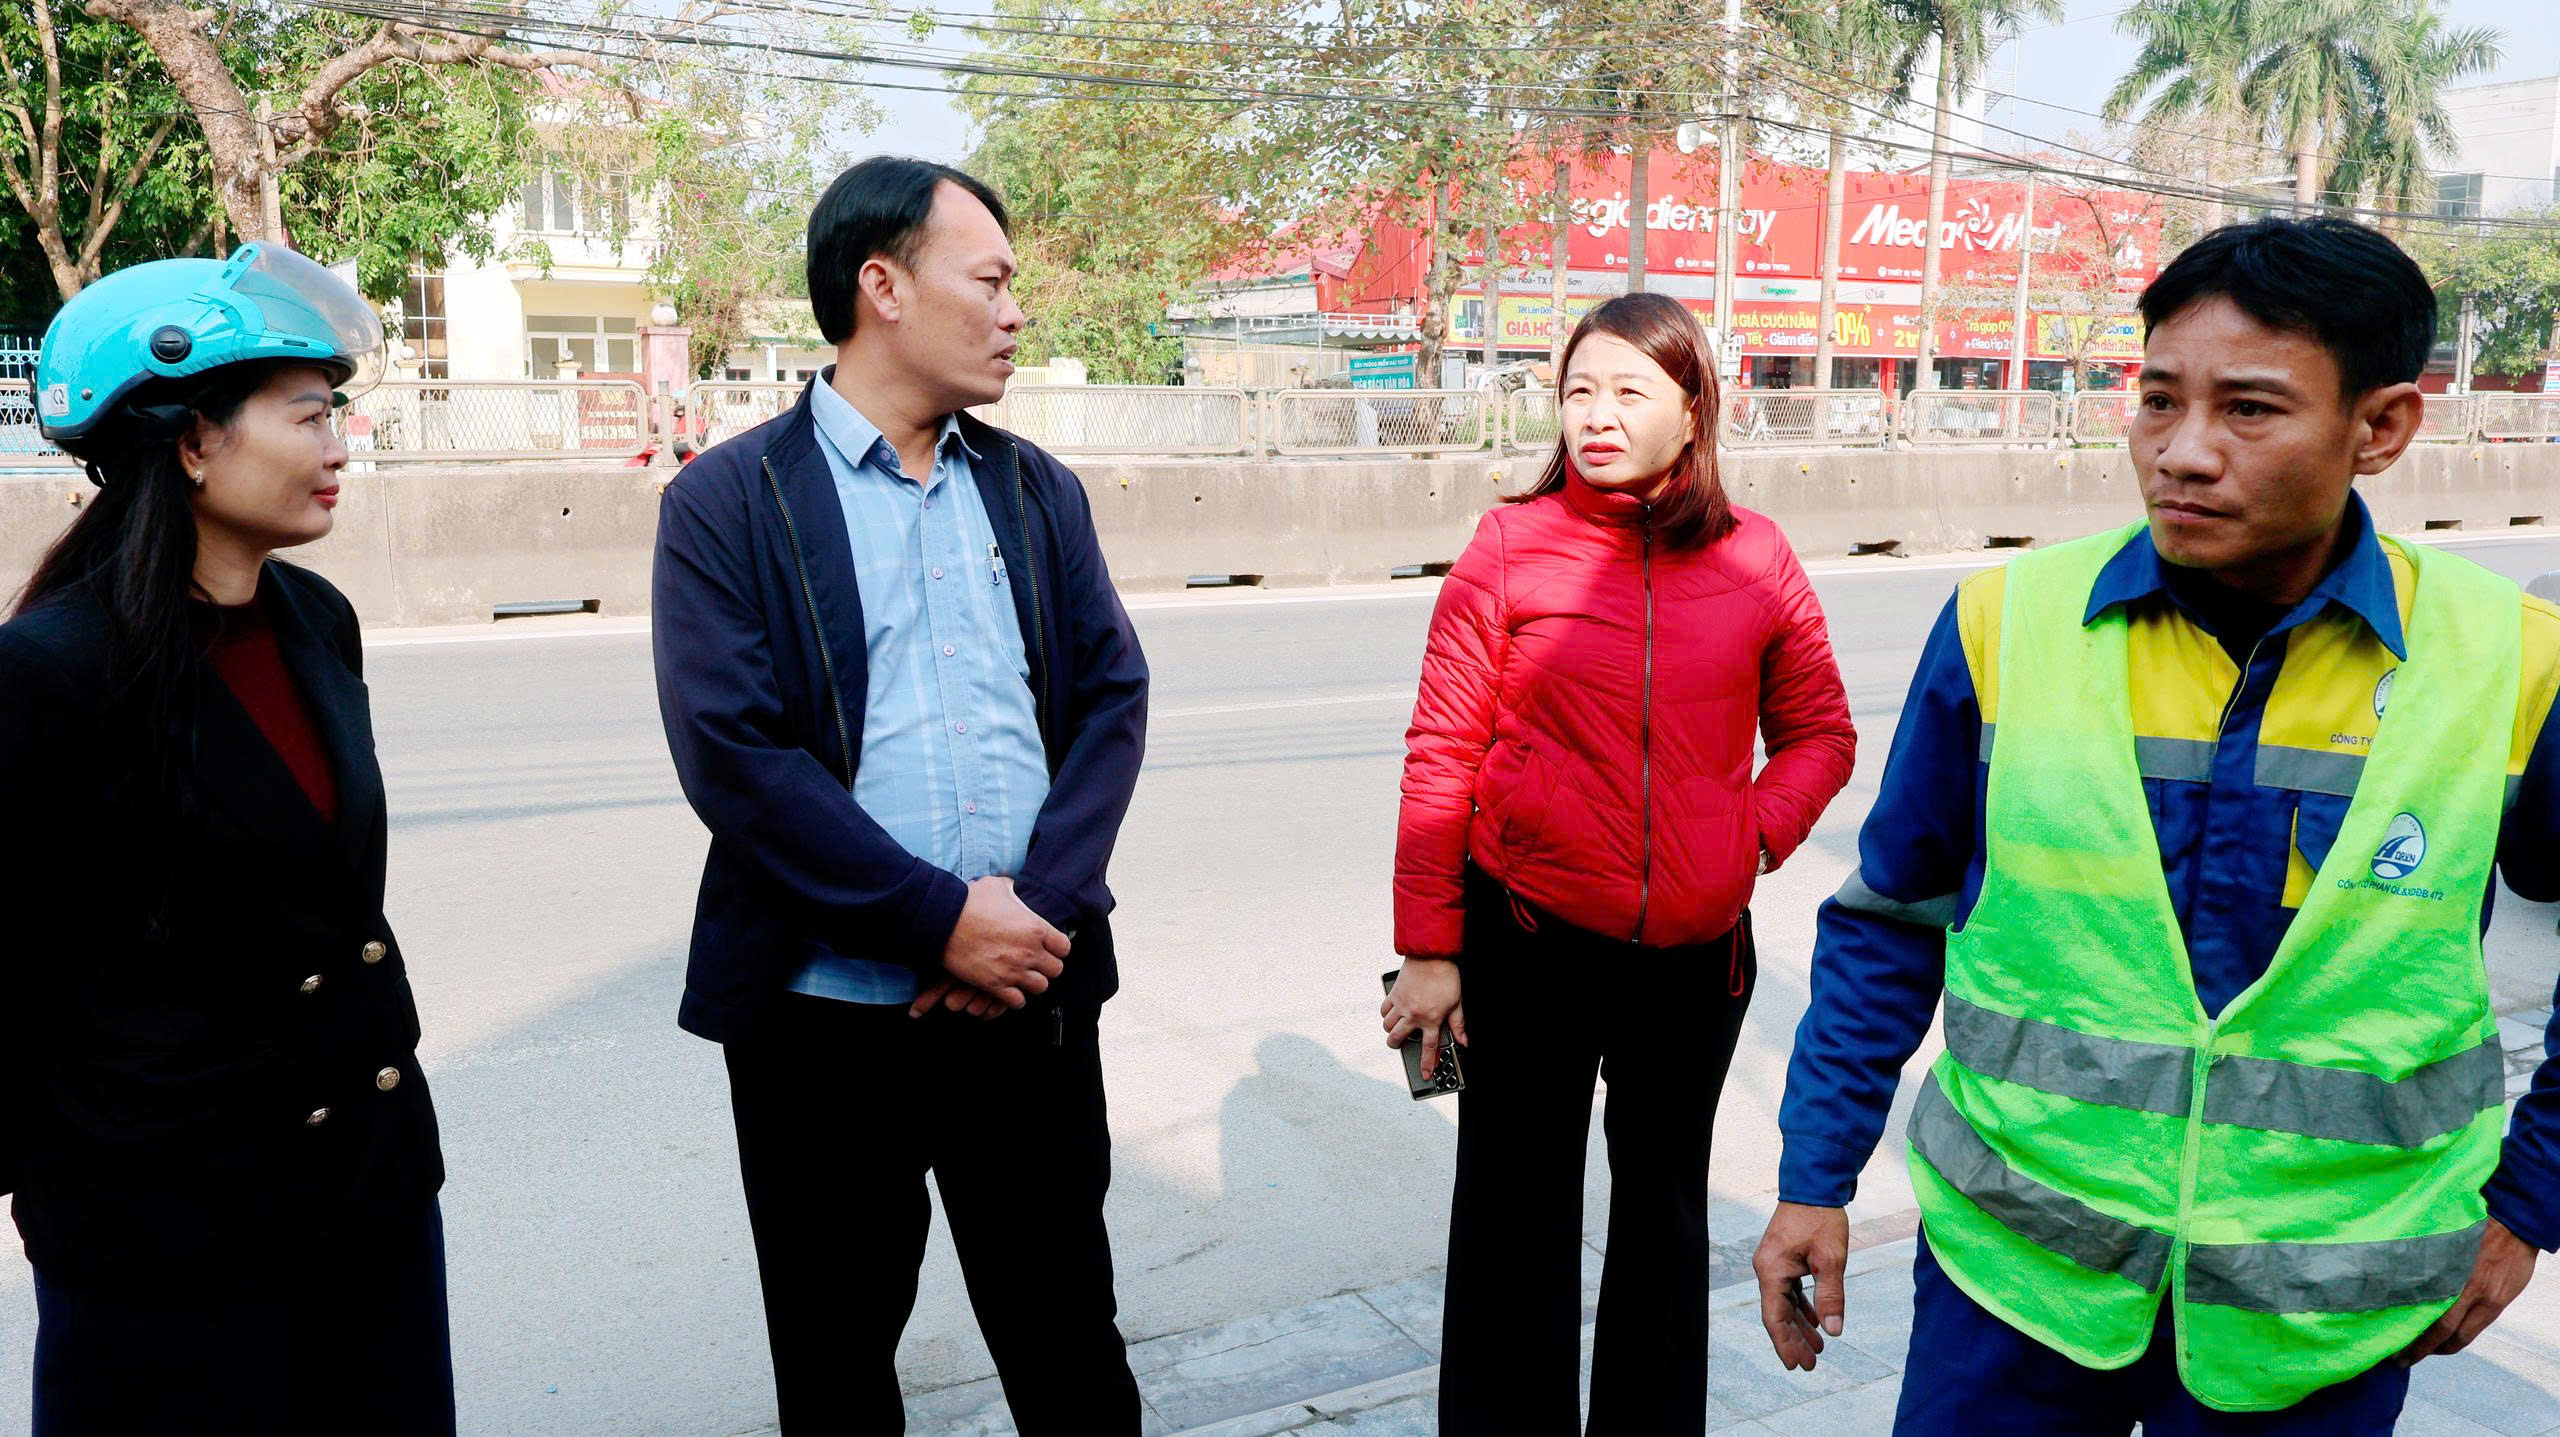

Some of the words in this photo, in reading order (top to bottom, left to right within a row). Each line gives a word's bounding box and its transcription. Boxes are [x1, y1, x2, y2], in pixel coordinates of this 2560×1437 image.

[1769, 331, 1796, 346] Giảm
[1797, 331, 1818, 347] đến
[2330, 732, 2358, 746] CÔNG
